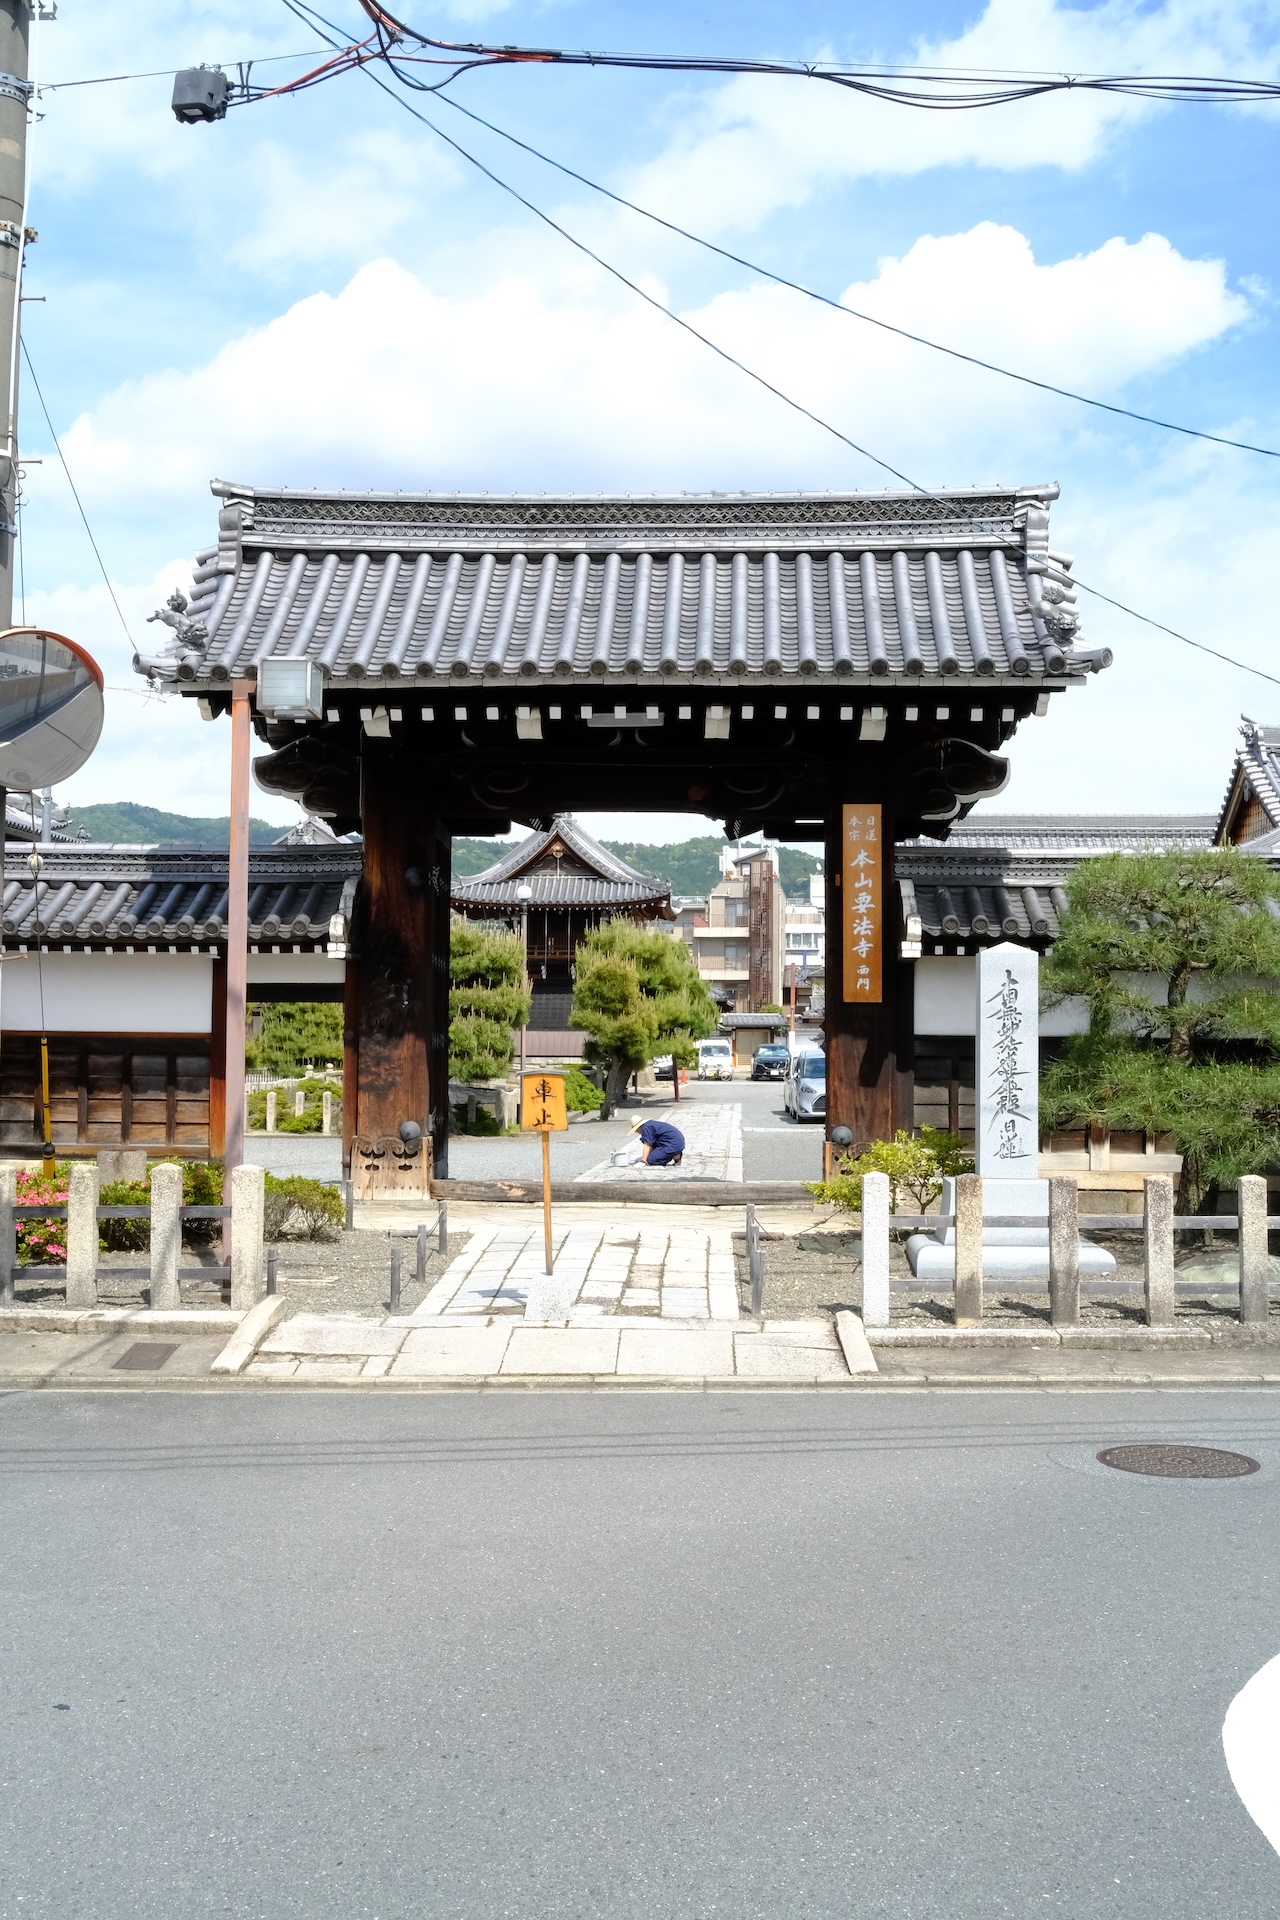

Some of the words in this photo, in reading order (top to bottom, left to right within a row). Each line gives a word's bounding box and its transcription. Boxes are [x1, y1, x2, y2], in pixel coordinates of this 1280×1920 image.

[848, 815, 862, 841] 本宗
[865, 815, 877, 841] 日蓮
[856, 964, 871, 991] 西門
[531, 1078, 557, 1127] 車止
